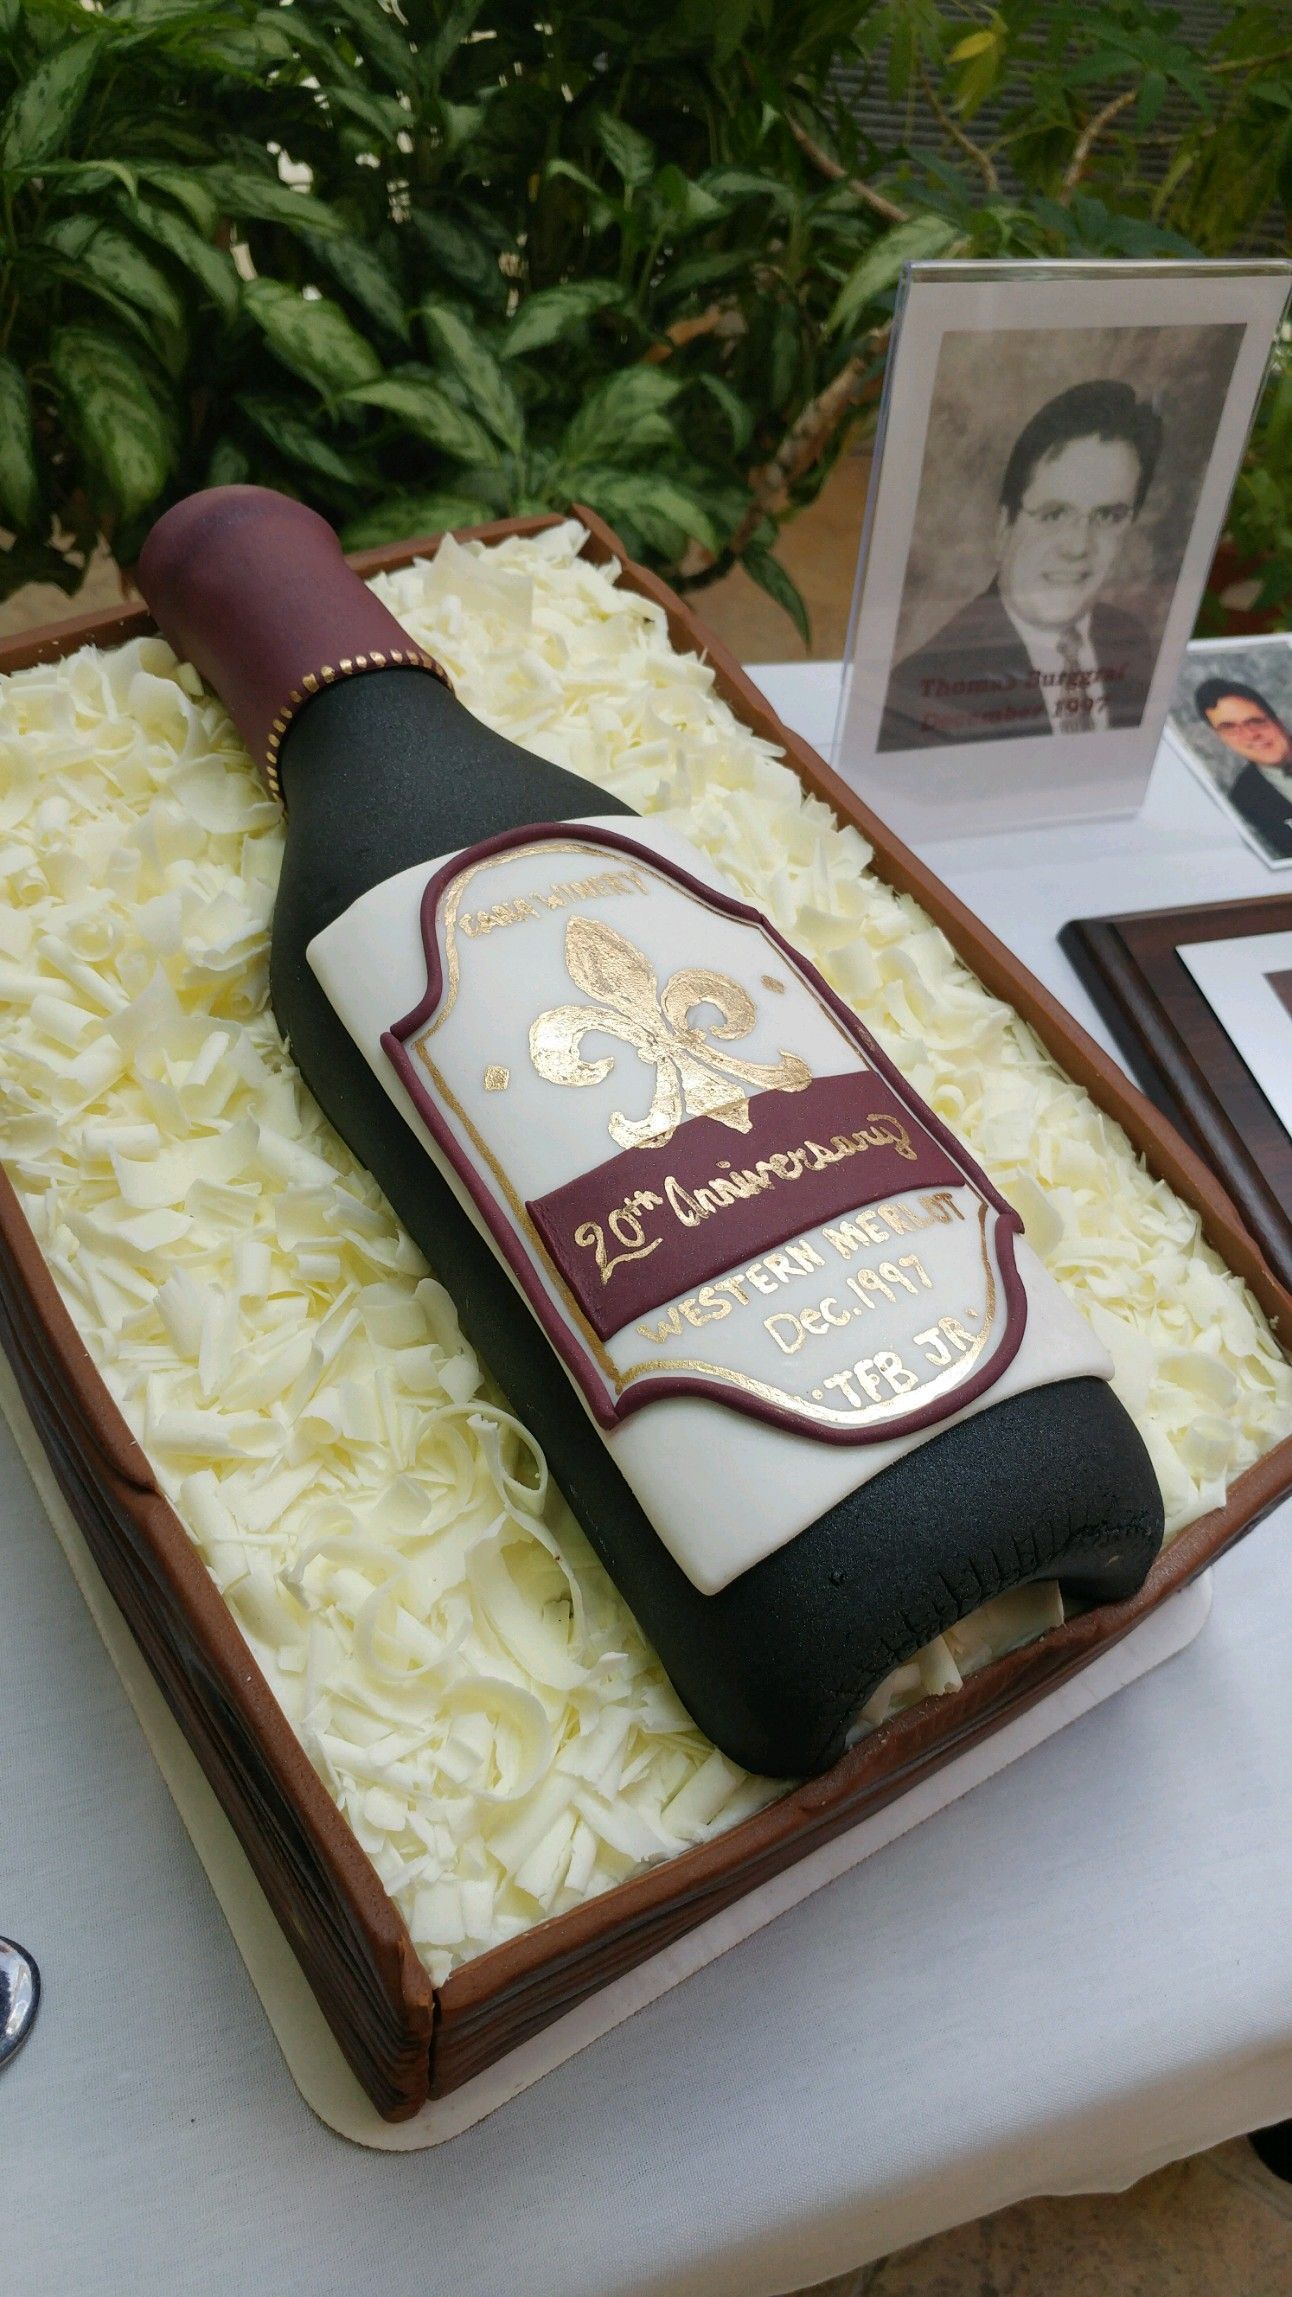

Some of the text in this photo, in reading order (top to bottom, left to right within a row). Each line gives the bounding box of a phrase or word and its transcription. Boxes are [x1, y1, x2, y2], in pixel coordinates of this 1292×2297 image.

[919, 675, 1017, 697] Thomas
[664, 1113, 919, 1228] Anniversary
[635, 1191, 966, 1345] WESTERN MERLOT
[822, 1351, 920, 1408] TFB
